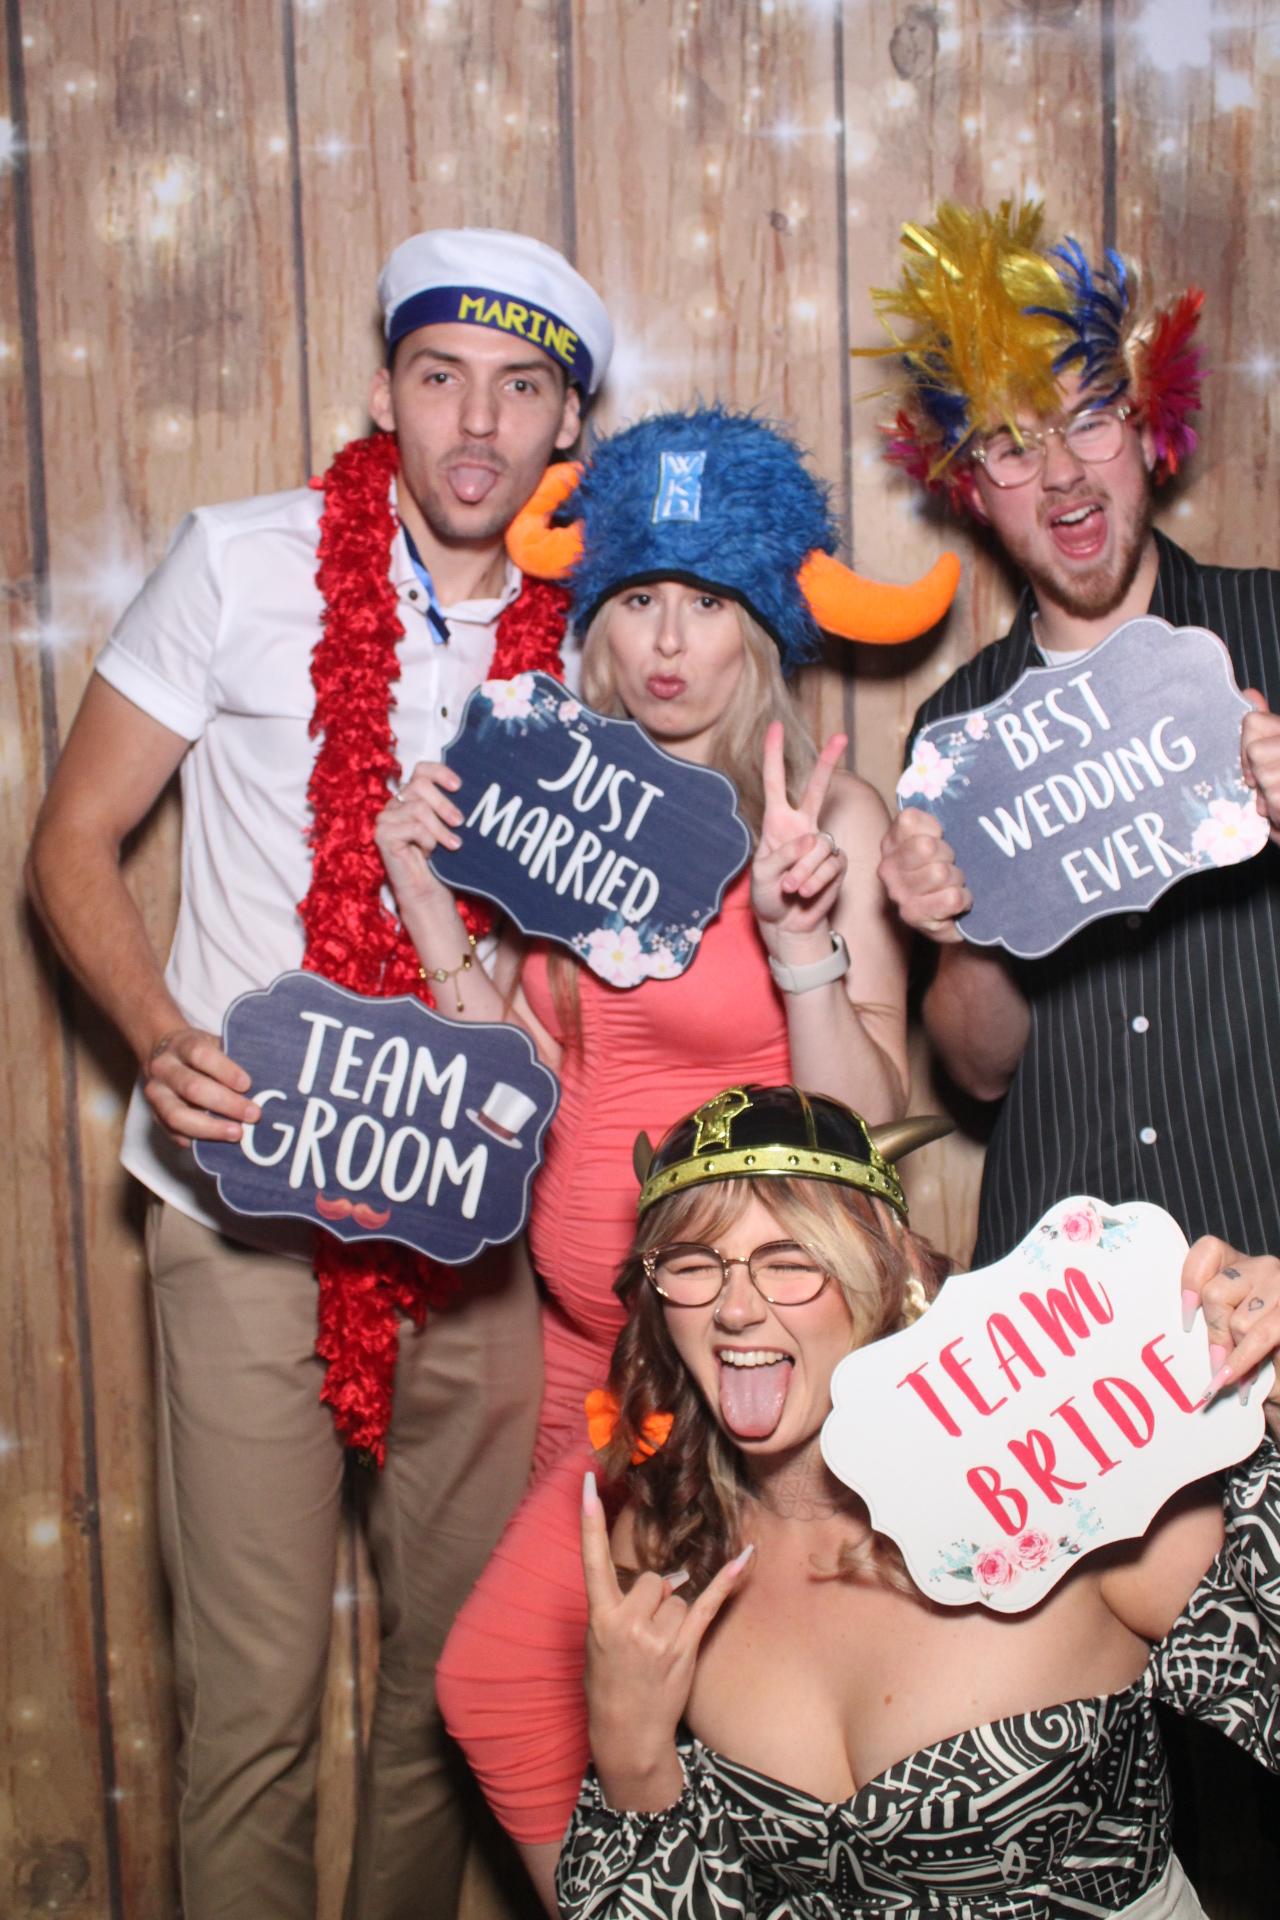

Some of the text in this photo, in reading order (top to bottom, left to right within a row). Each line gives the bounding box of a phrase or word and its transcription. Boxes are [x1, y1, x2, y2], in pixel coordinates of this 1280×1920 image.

[458, 294, 578, 364] MARINE
[995, 671, 1111, 771] BEST
[537, 730, 664, 841] JUST
[979, 716, 1197, 858] WEDDING
[465, 783, 659, 923] MARRIED
[1061, 812, 1191, 903] EVER
[297, 1011, 467, 1129] TEAM
[240, 1089, 488, 1219] GROOM
[896, 1267, 1114, 1437] TEAM
[966, 1333, 1208, 1536] BRIDE
